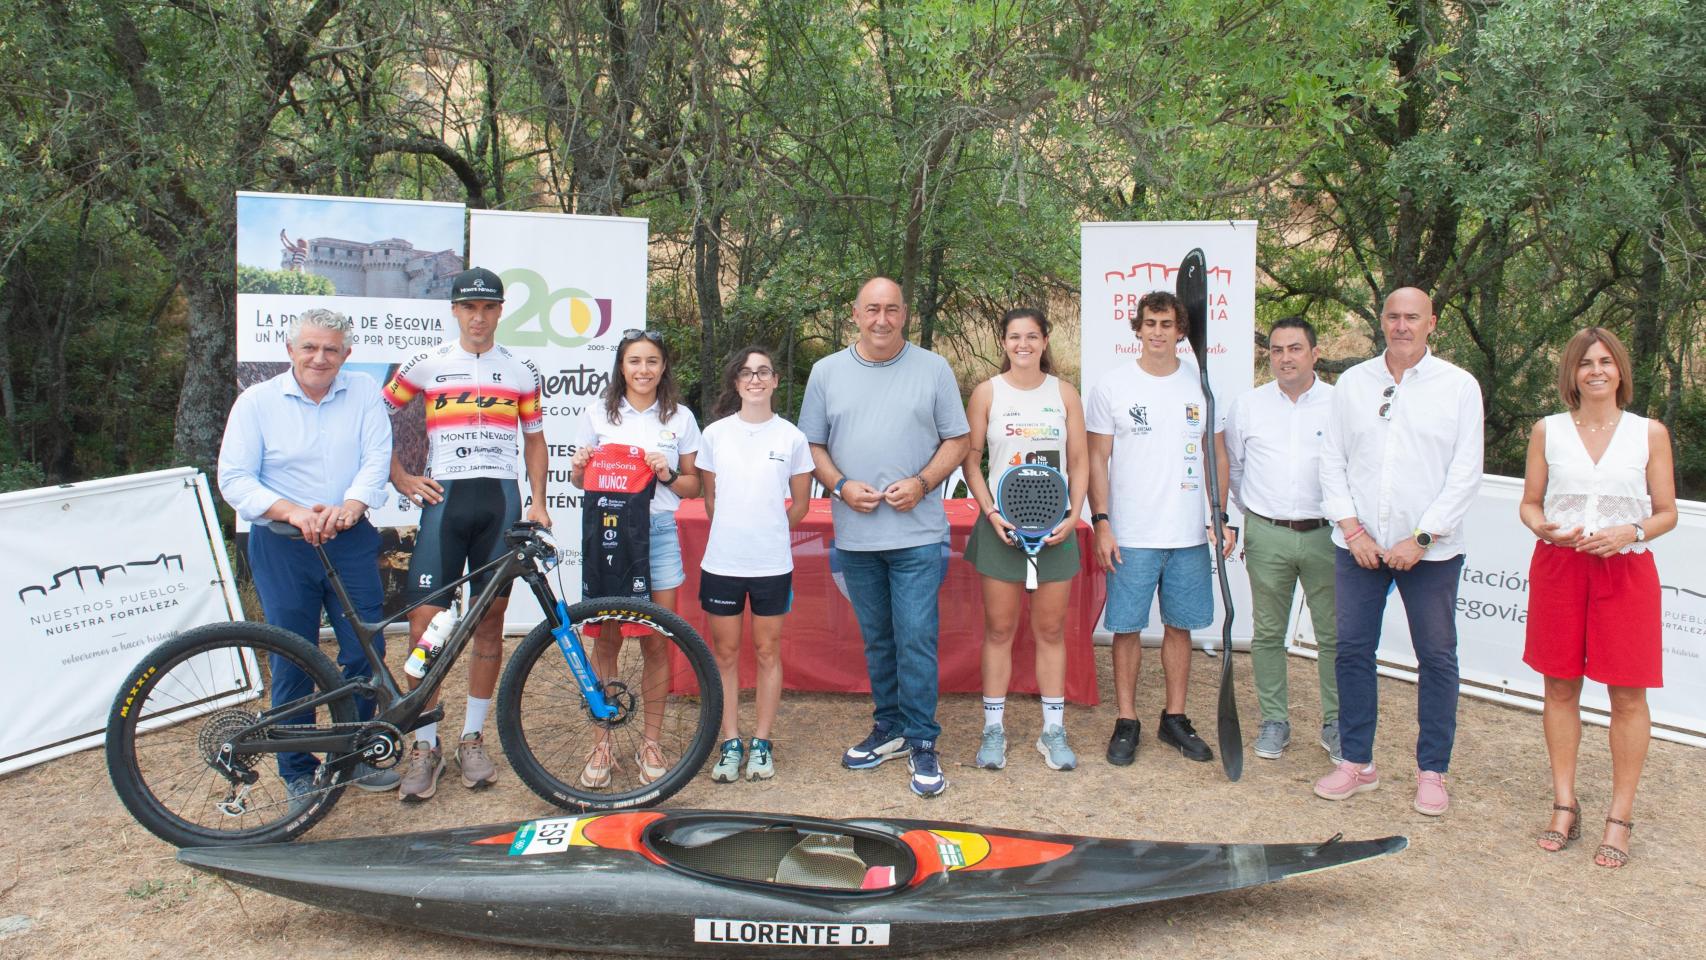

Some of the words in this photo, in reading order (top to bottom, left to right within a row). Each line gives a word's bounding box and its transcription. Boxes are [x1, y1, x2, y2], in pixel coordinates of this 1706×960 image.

[361, 316, 378, 329] DE
[385, 313, 443, 331] SEGOVIA
[255, 331, 270, 343] UN
[364, 334, 383, 346] POR
[1115, 343, 1142, 354] Puebl
[441, 432, 478, 442] MONTE
[480, 430, 514, 442] NEVADO
[592, 459, 637, 471] #eligeSoria
[598, 472, 628, 489] MUÑOZ
[30, 599, 114, 626] NUESTROS
[46, 617, 105, 637] NUESTRA
[110, 599, 180, 621] FORTALEZA
[597, 609, 652, 620] MAXXIS
[62, 648, 110, 666] volveremos
[120, 639, 145, 651] hacer
[120, 666, 157, 718] MAXXIS
[537, 822, 569, 845] ESP
[710, 921, 840, 945] LLORENTE
[851, 926, 874, 945] D.
